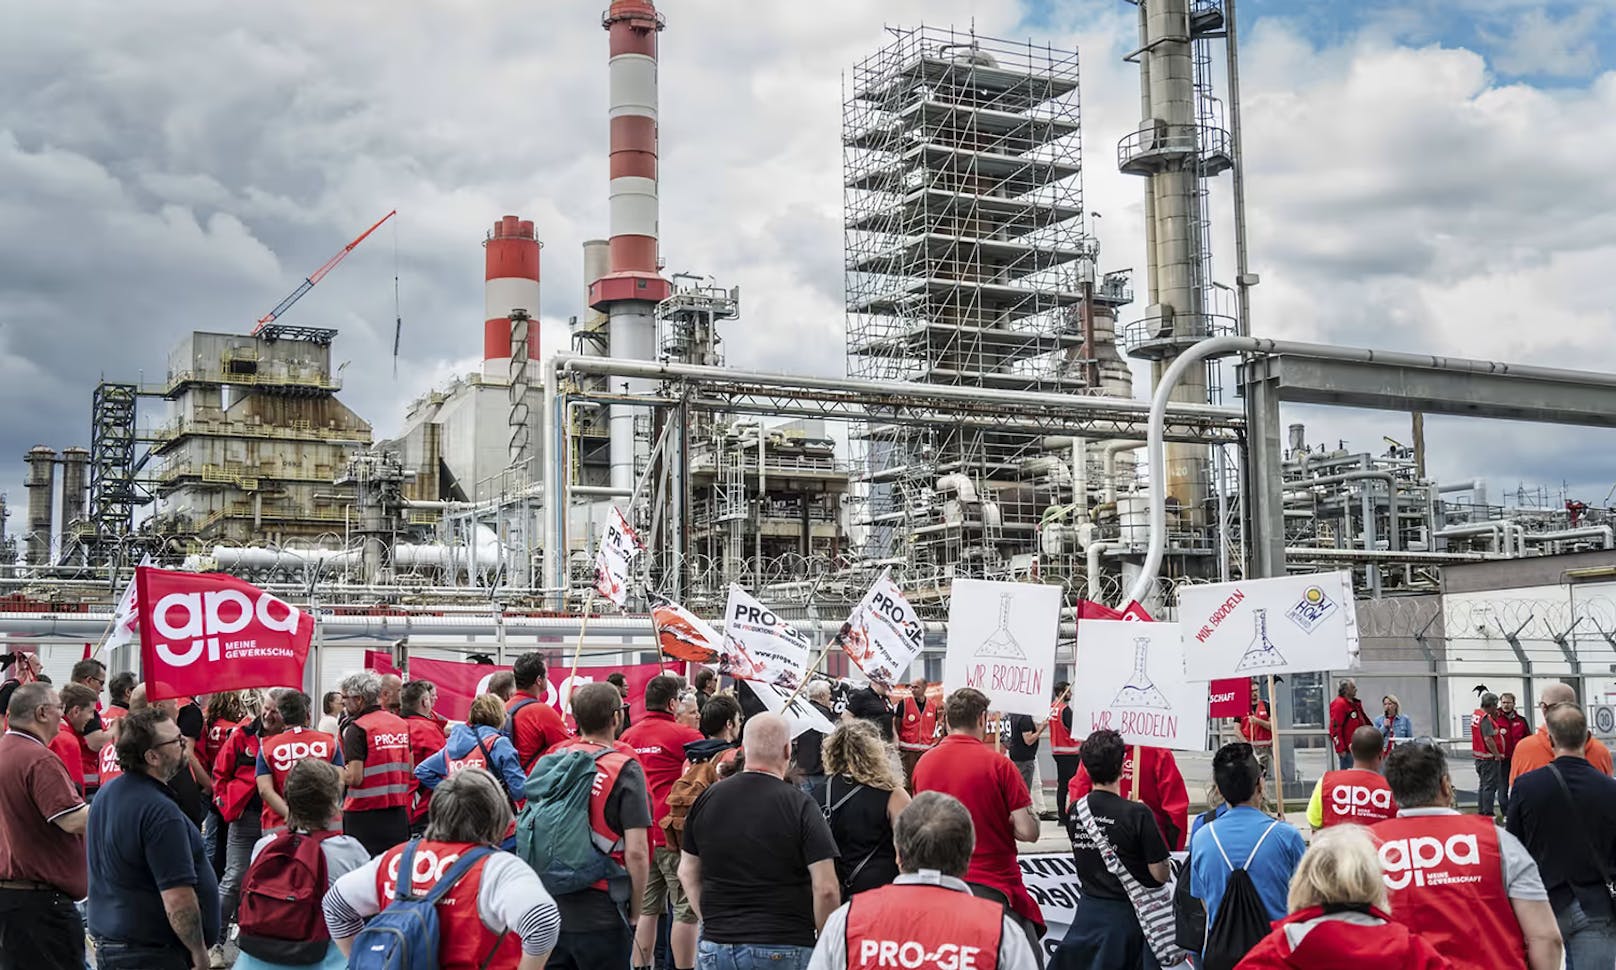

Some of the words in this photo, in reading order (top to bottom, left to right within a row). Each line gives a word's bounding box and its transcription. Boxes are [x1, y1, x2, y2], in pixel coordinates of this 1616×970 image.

[153, 589, 300, 667] gpa
[872, 592, 923, 648] PRO-GE
[1195, 625, 1215, 643] WIR
[1208, 588, 1246, 628] BRODELN
[225, 640, 256, 650] MEINE
[966, 664, 986, 688] WIR
[991, 664, 1043, 695] BRODELN
[374, 733, 409, 746] PRO-GE
[1091, 710, 1113, 732] WIR
[1120, 710, 1178, 738] BRODELN
[273, 741, 328, 771] gpa
[1331, 785, 1391, 815] gpa
[1378, 834, 1480, 890] gpa
[860, 939, 981, 970] PRO-GE
